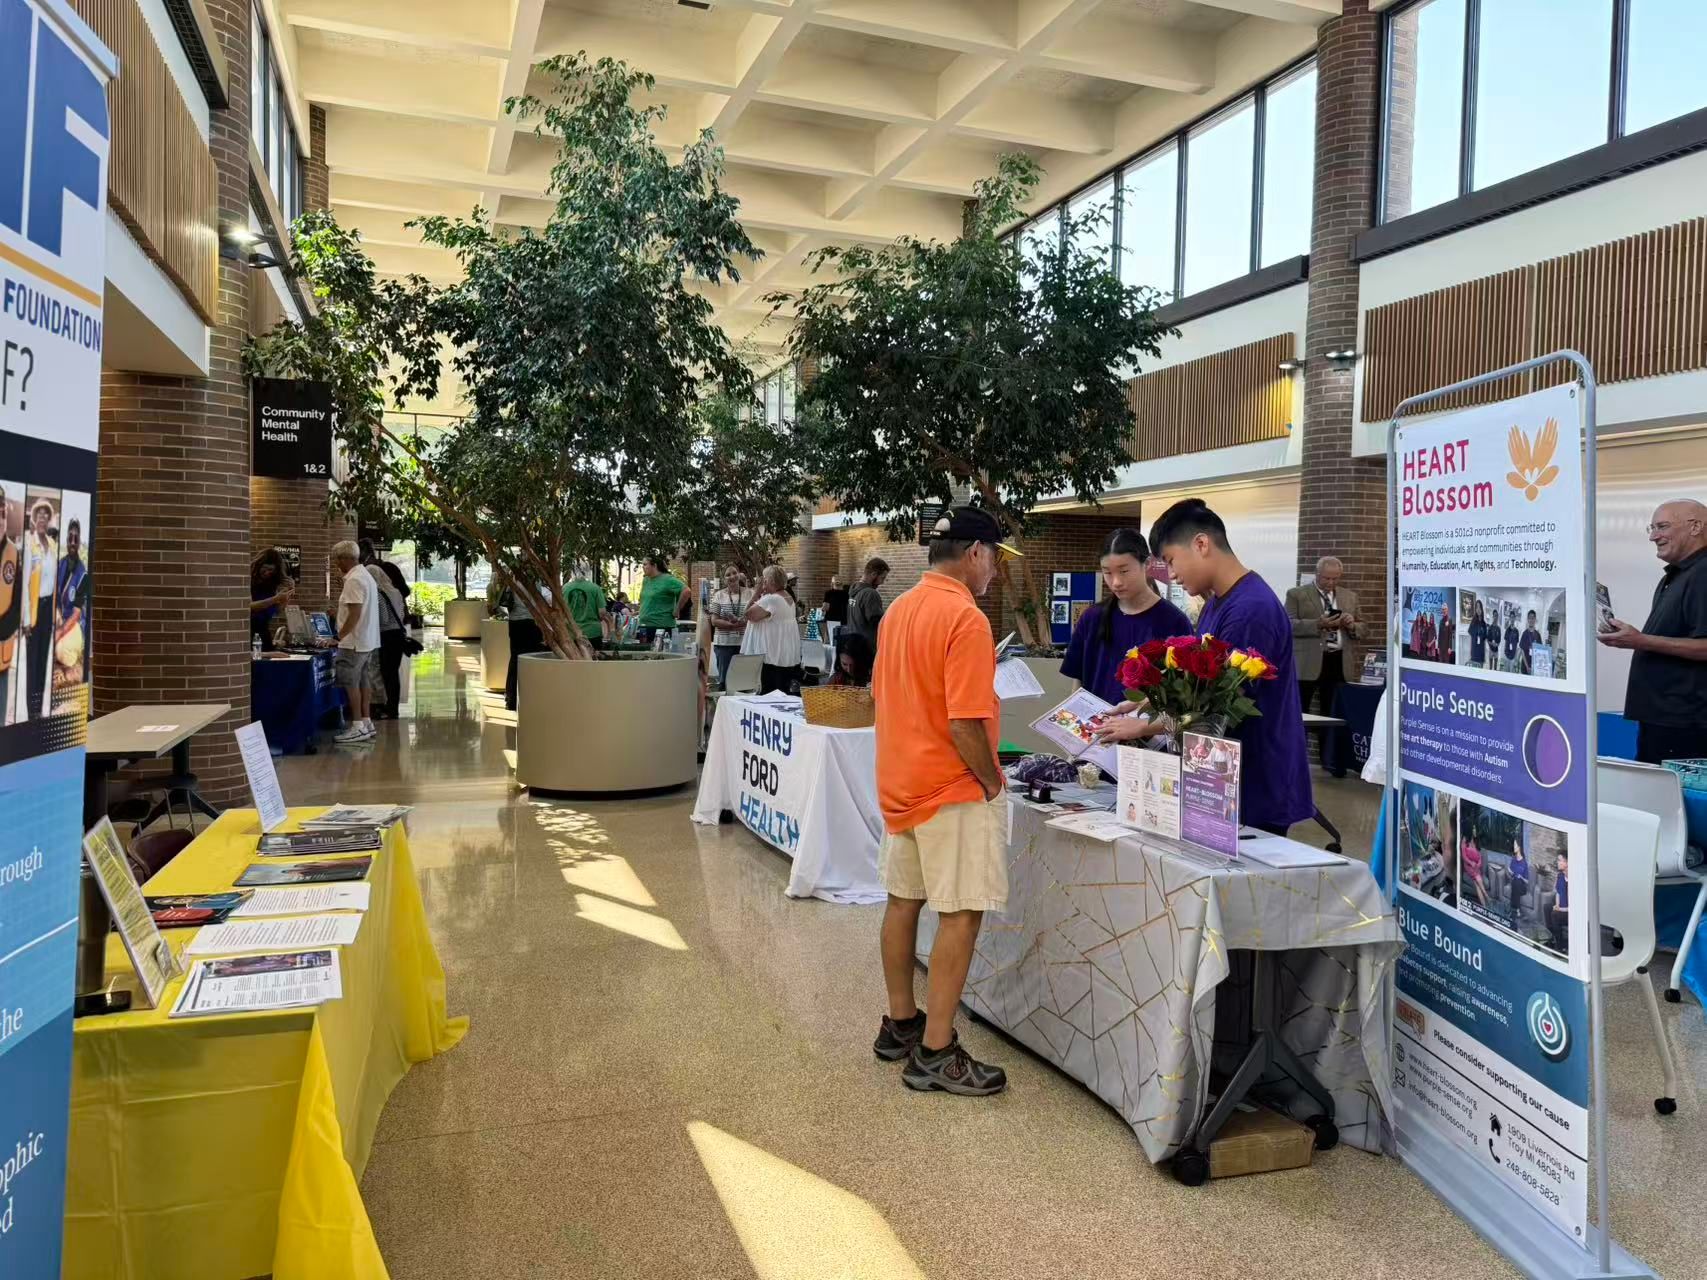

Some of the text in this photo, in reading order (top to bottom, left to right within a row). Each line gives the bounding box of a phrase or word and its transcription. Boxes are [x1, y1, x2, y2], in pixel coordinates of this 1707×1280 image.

[3, 278, 101, 353] FOUNDATION
[262, 406, 325, 421] Community
[262, 418, 299, 430] Mental
[262, 430, 298, 442] Health
[303, 463, 326, 474] 1&2
[1403, 439, 1469, 481] HEART
[1402, 480, 1493, 516] Blossom
[1402, 530, 1420, 541] HEART
[1420, 530, 1443, 540] Blossom
[1444, 528, 1449, 538] is
[1455, 527, 1473, 537] 501c3
[1474, 524, 1504, 538] nonprofit
[1506, 521, 1545, 534] committed
[1547, 522, 1556, 532] to
[1402, 539, 1553, 557] empowering individuals and communities through
[1402, 558, 1557, 572] Humanity, Education, Art, Rights, and Technology.
[1400, 682, 1494, 722] Purple Sense
[740, 708, 793, 757] HENRY
[1400, 715, 1514, 752] Purple Sense is on a mission to provide
[1411, 734, 1420, 743] art
[1420, 736, 1443, 751] therapy
[1444, 742, 1450, 752] to
[1452, 744, 1468, 757] those
[1470, 749, 1483, 760] with
[1484, 752, 1508, 768] Autism
[742, 749, 779, 796] FORD
[1401, 746, 1504, 784] and other developmental disorders.
[739, 791, 800, 850] HEALTH
[1399, 906, 1482, 971] Blue Bound
[1409, 974, 1440, 1000] promoting
[1411, 943, 1431, 961] Bound
[1432, 957, 1437, 965] is
[1437, 959, 1468, 984] dedicated
[1469, 978, 1477, 989] to
[1477, 984, 1513, 1014] advancing
[1423, 967, 1447, 987] support,
[1449, 982, 1471, 1004] raising
[1471, 995, 1509, 1027] awareness,
[1408, 1053, 1478, 1111] www.heart-blossom.org
[1409, 1063, 1473, 1120] www.purple-sense.org
[1433, 1029, 1570, 1130] Please consider supporting our cause
[1408, 1081, 1478, 1145] info@heart-blossom.org
[1508, 1137, 1562, 1184] Troy MI 48083
[1528, 1138, 1563, 1171] Livernois
[1563, 1164, 1575, 1180] Rd
[1505, 1158, 1560, 1206] 248-808-5828
